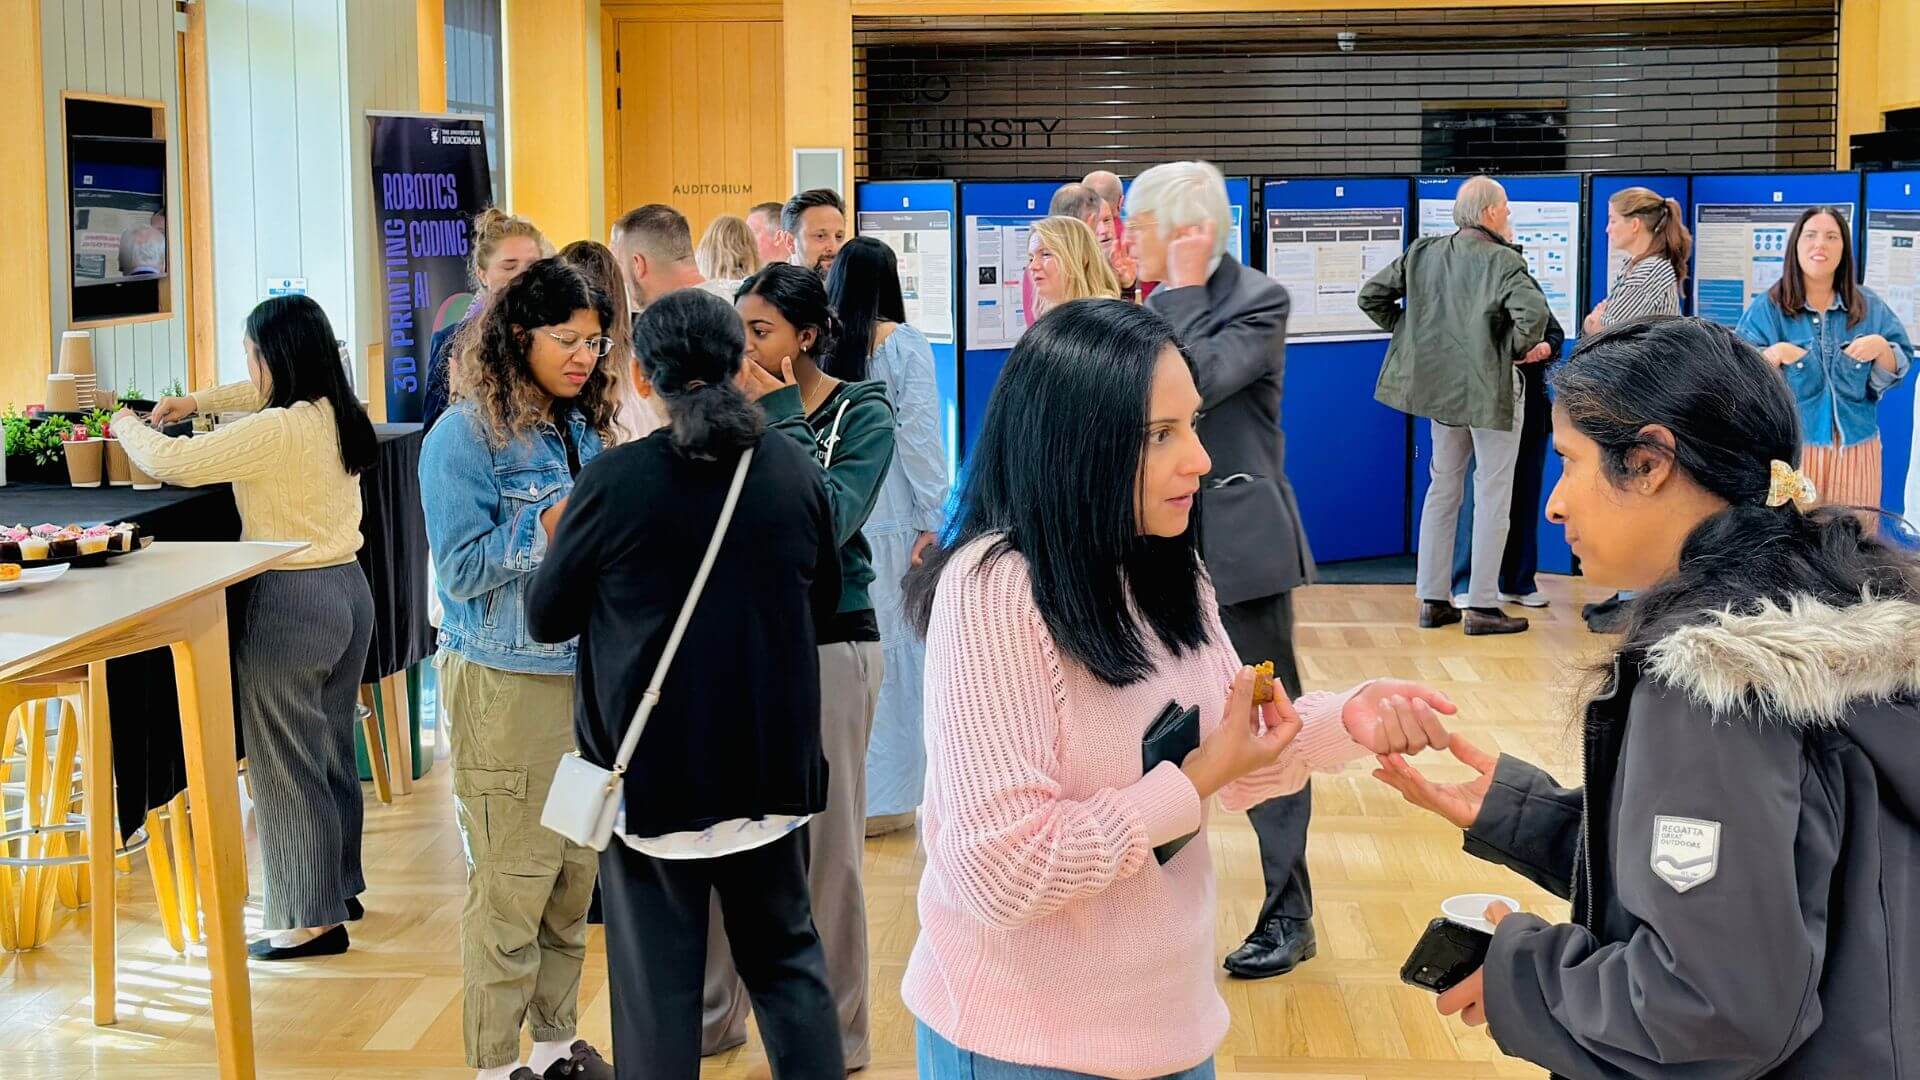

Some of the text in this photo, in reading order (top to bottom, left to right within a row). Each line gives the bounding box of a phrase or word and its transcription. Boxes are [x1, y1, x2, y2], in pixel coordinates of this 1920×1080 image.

[442, 136, 481, 145] BUCKINGHAM
[897, 118, 1062, 149] THIRSTY
[383, 173, 458, 211] ROBOTICS
[673, 184, 752, 194] AUDITORIUM
[409, 219, 468, 258] CODING
[414, 271, 431, 309] AI
[384, 218, 418, 394] 3D PRINTING
[1661, 839, 1701, 848] OUTDOORS
[1662, 824, 1704, 836] REGATTA
